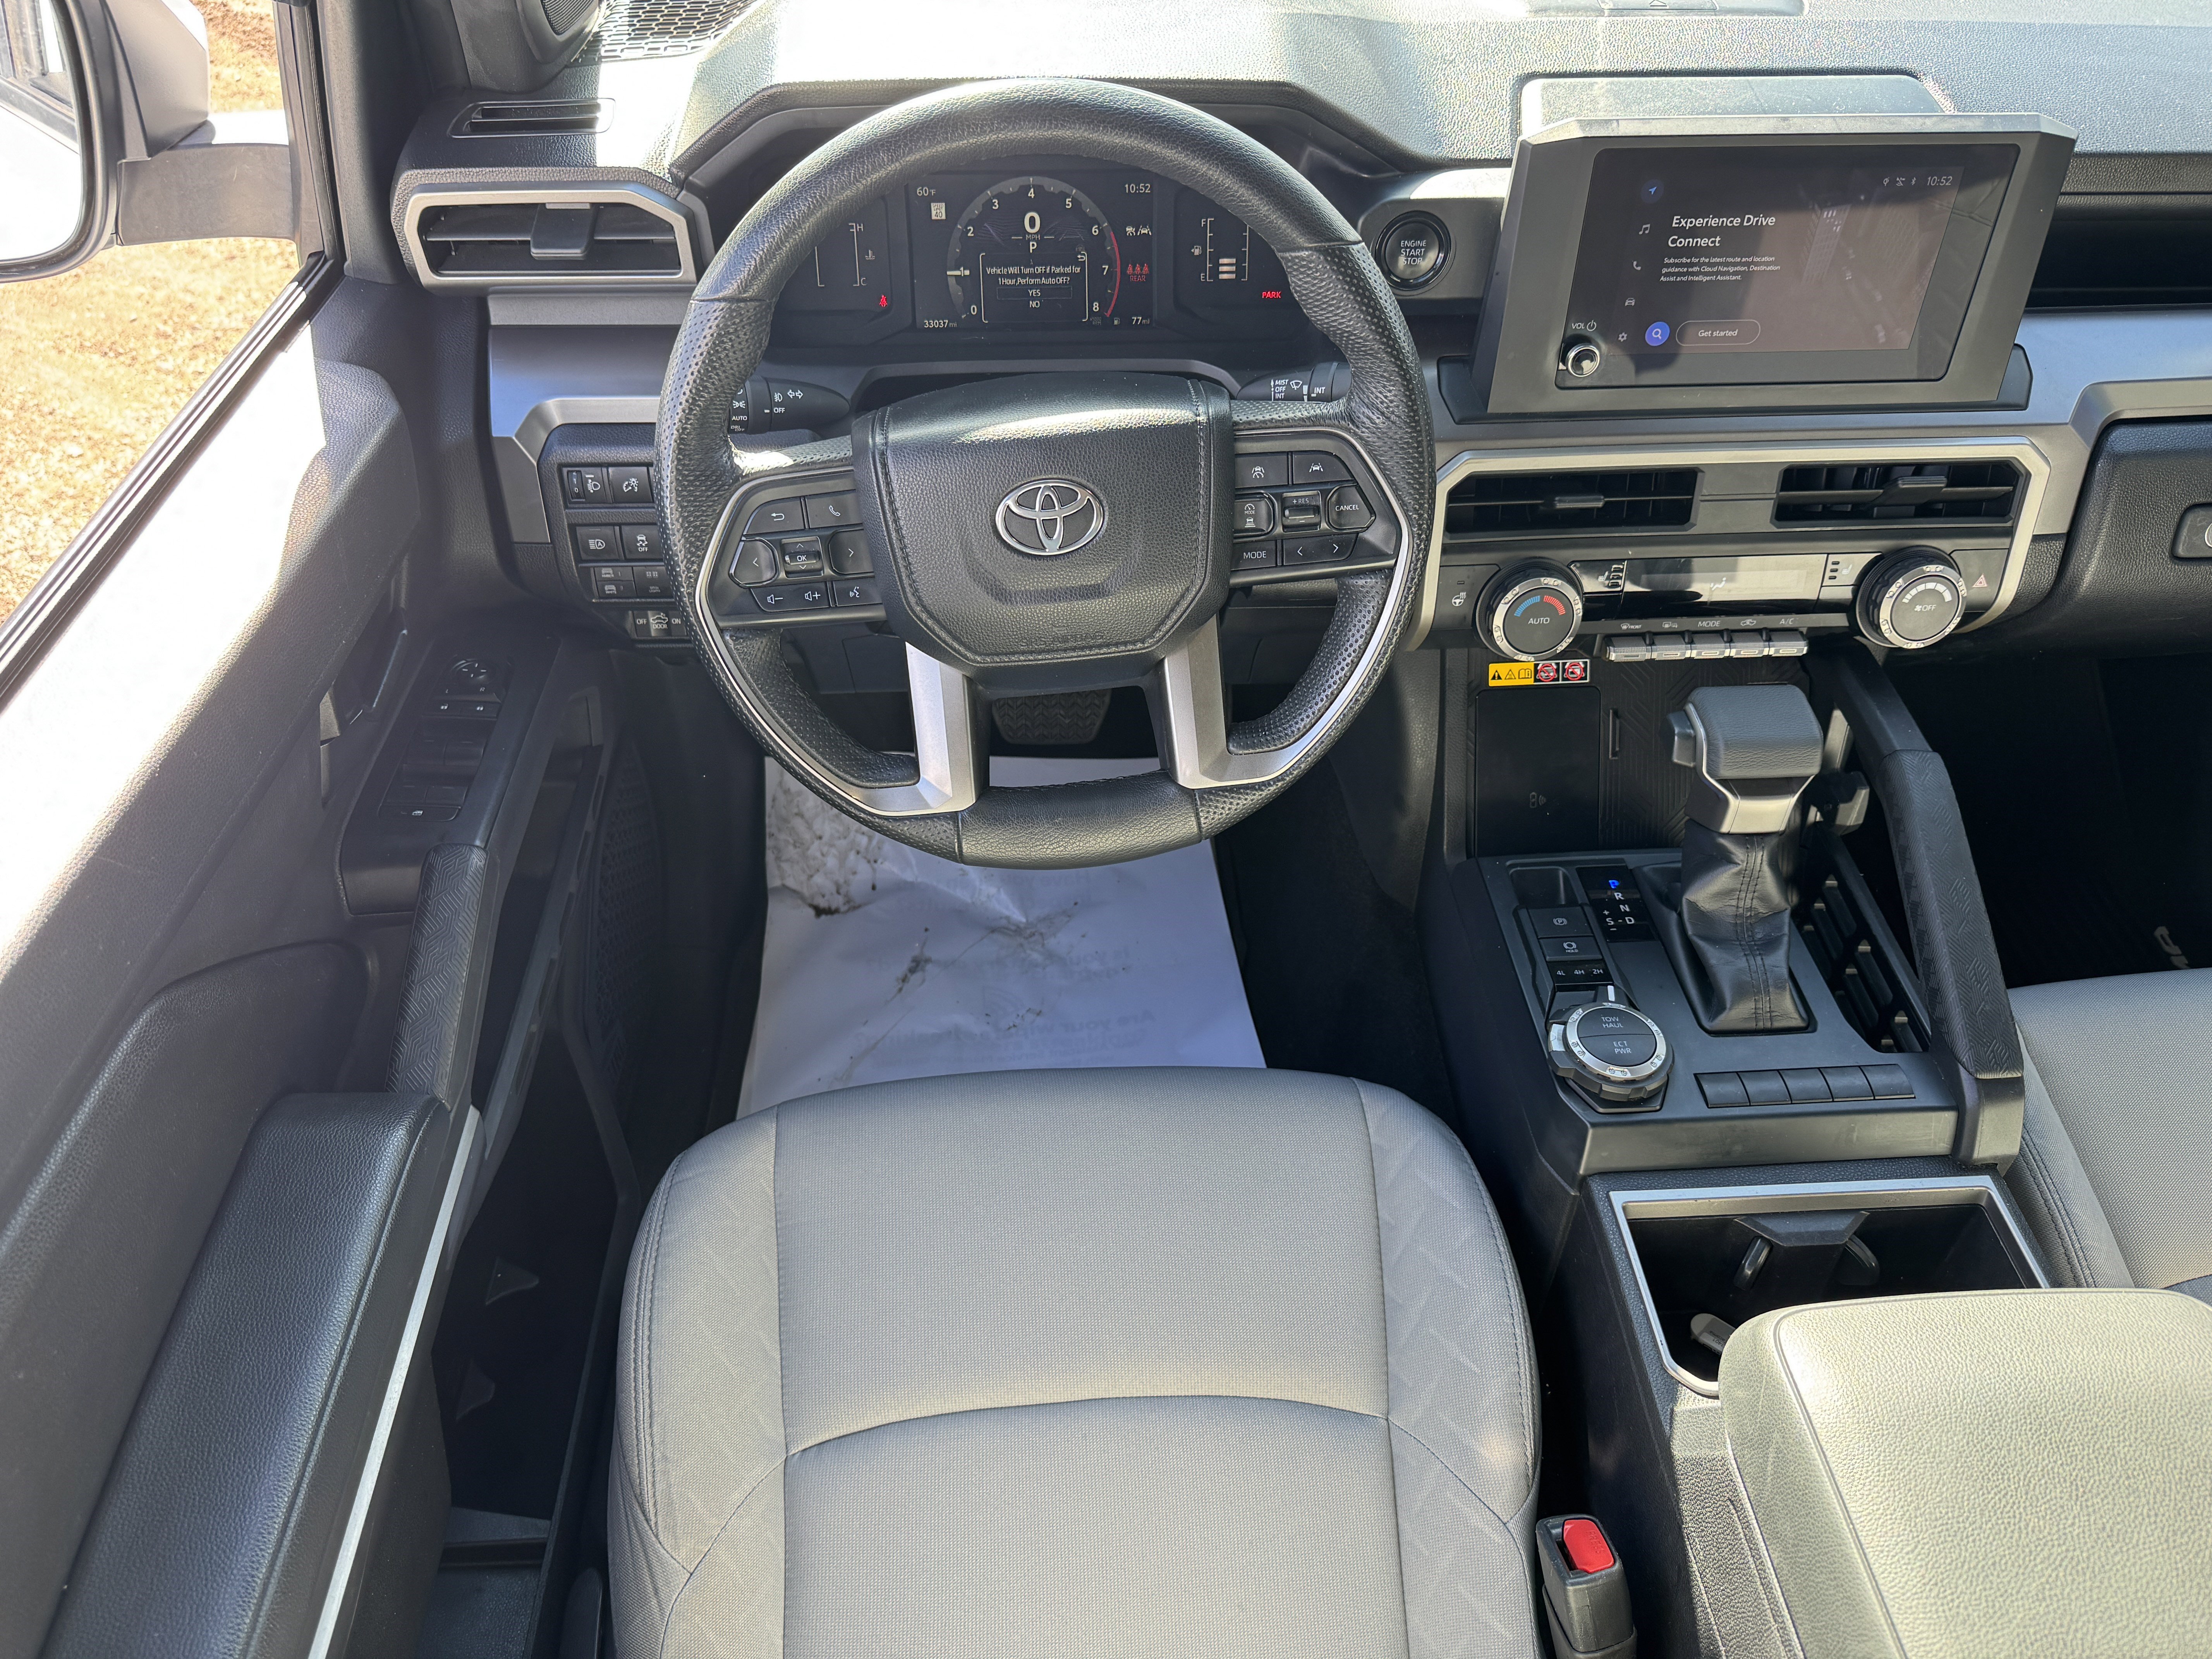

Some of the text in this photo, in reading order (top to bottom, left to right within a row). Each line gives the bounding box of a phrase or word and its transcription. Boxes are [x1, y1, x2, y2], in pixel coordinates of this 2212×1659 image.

[1927, 176, 1952, 185] 10:52
[1028, 188, 1034, 198] 4
[1125, 184, 1150, 193] 10:52
[993, 199, 998, 209] 3
[1066, 199, 1072, 208] 5
[1024, 212, 1040, 233] 0
[1673, 215, 1775, 229] Experience Drive
[967, 227, 974, 236] 2
[1092, 225, 1098, 235] 6
[1668, 236, 1721, 247] Connect
[1030, 242, 1037, 253] P
[1400, 249, 1425, 257] START
[1403, 257, 1423, 265] STOP
[959, 267, 963, 276] 1
[1103, 266, 1108, 275] 7
[971, 305, 977, 314] 0
[1093, 302, 1099, 311] 8
[1609, 880, 1619, 888] P
